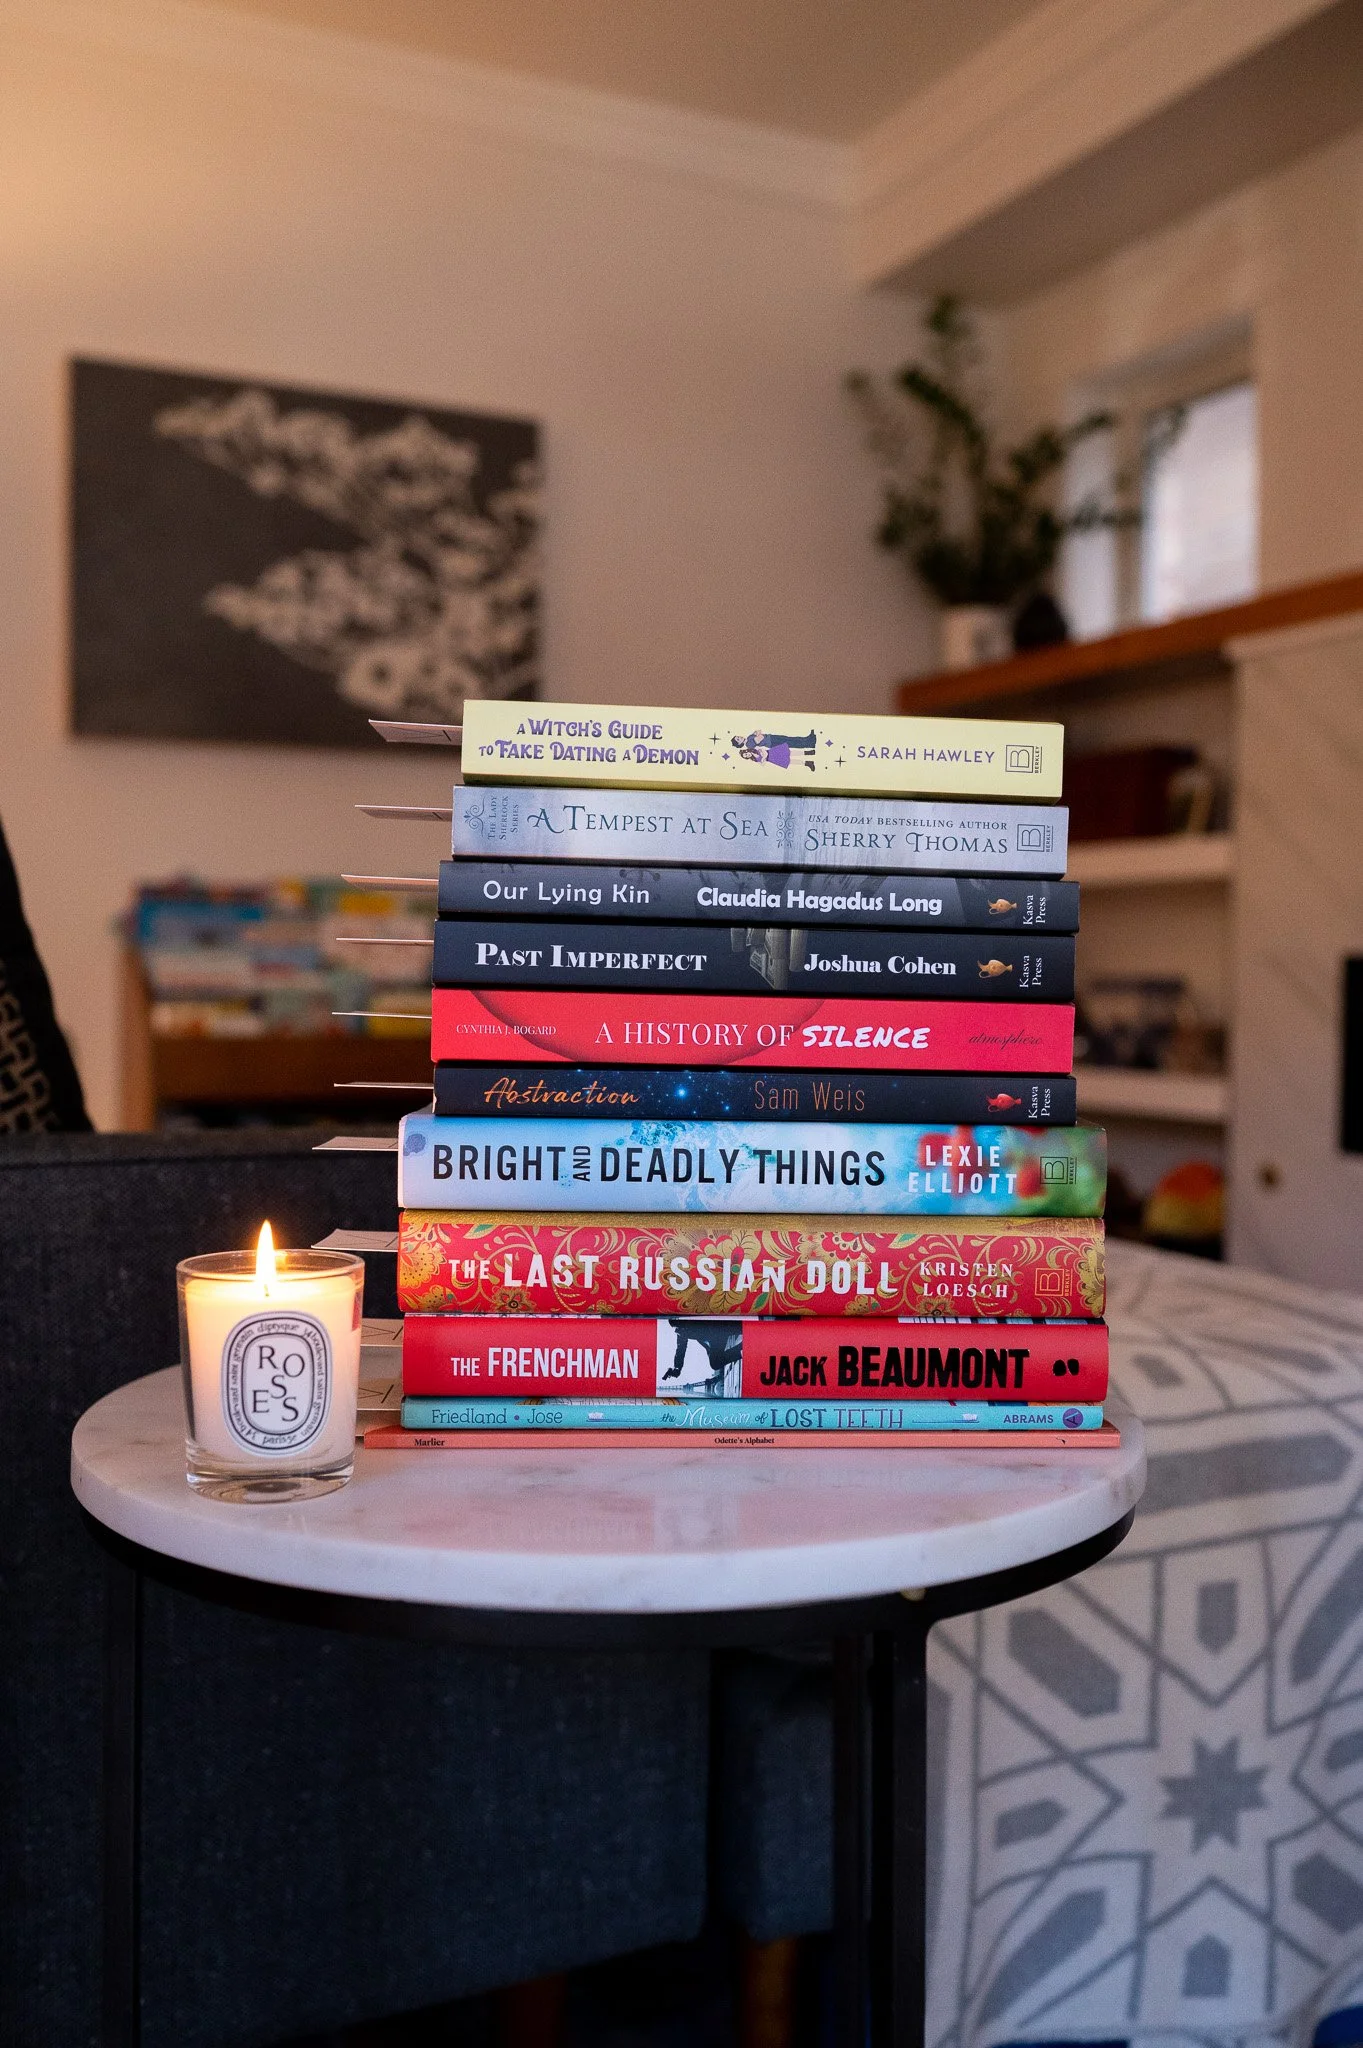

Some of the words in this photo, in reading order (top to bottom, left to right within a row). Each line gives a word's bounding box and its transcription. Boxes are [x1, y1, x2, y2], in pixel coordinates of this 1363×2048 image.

[516, 724, 526, 734] A
[528, 718, 602, 738] WITCH'S
[608, 720, 663, 740] GUIDE
[479, 745, 494, 757] TO
[495, 740, 544, 760] FAKE
[550, 741, 617, 763] DATING
[622, 749, 632, 762] A
[633, 744, 700, 766] DEMON
[858, 746, 916, 761] SARAH
[923, 749, 996, 764] HAWLEY
[488, 796, 498, 818] LADY
[499, 796, 508, 840] SHERLOCK
[510, 804, 520, 833] SERIES
[488, 822, 496, 840] THE
[527, 808, 564, 834] A
[562, 805, 674, 833] TEMPEST
[682, 817, 712, 836] AT
[719, 811, 769, 840] SEA
[808, 814, 828, 824] USA
[834, 816, 874, 825] TODAY
[877, 818, 954, 828] BESTSELLING
[959, 820, 1008, 830] AUTHOR
[804, 828, 896, 851] SHERRY
[906, 832, 1008, 854] THOMAS
[483, 880, 528, 900] Our
[538, 882, 602, 905] Lying
[612, 884, 650, 904] Kin
[697, 886, 780, 908] Claudia
[787, 890, 883, 914] Hagadus
[890, 893, 942, 916] Long
[1022, 894, 1034, 926] Kasva
[1036, 897, 1046, 924] Press
[474, 942, 543, 967] PAST
[550, 945, 707, 971] IMPERFECT
[804, 954, 882, 974] Joshua
[888, 956, 956, 976] Cohen
[1020, 955, 1030, 988] Kasva
[1032, 958, 1042, 986] Press
[456, 1024, 502, 1035] CYNTHIA
[504, 1025, 511, 1036] J.
[513, 1026, 556, 1036] BOGARD
[595, 1022, 614, 1044] A
[624, 1022, 748, 1046] HISTORY
[756, 1024, 794, 1047] OF
[802, 1025, 931, 1050] SILENCE
[968, 1029, 1042, 1050] atmosphere
[484, 1077, 642, 1109] Abstraction
[754, 1080, 798, 1110] Sam
[812, 1081, 866, 1112] Weis
[1028, 1086, 1039, 1119] Kasva
[1040, 1088, 1051, 1117] Press
[433, 1144, 566, 1181] BRIGHT
[573, 1145, 591, 1182] AND
[600, 1147, 740, 1184] DEADLY
[753, 1150, 886, 1186] THINGS
[926, 1145, 1001, 1168] LEXIE
[908, 1172, 1018, 1194] ELLIOTT
[448, 1258, 490, 1280] THE
[504, 1254, 600, 1289] LAST
[620, 1255, 786, 1292] RUSSIAN
[806, 1260, 898, 1295] DOLL
[920, 1261, 1013, 1278] KRISTEN
[923, 1283, 1008, 1298] LOESCH
[451, 1357, 480, 1376] THE
[488, 1347, 639, 1379] FRENCHMAN
[760, 1356, 828, 1386] JACK
[838, 1346, 1030, 1388] BEAUMONT
[432, 1408, 508, 1425] Friedland
[527, 1408, 563, 1425] Jose
[660, 1412, 677, 1424] the
[675, 1406, 751, 1428] Museum
[754, 1411, 770, 1424] of
[770, 1408, 827, 1428] LOST
[834, 1408, 904, 1428] TEETH
[1004, 1414, 1054, 1424] ABRAMS
[414, 1438, 446, 1447] Marlier
[744, 1437, 775, 1446] Alphabet
